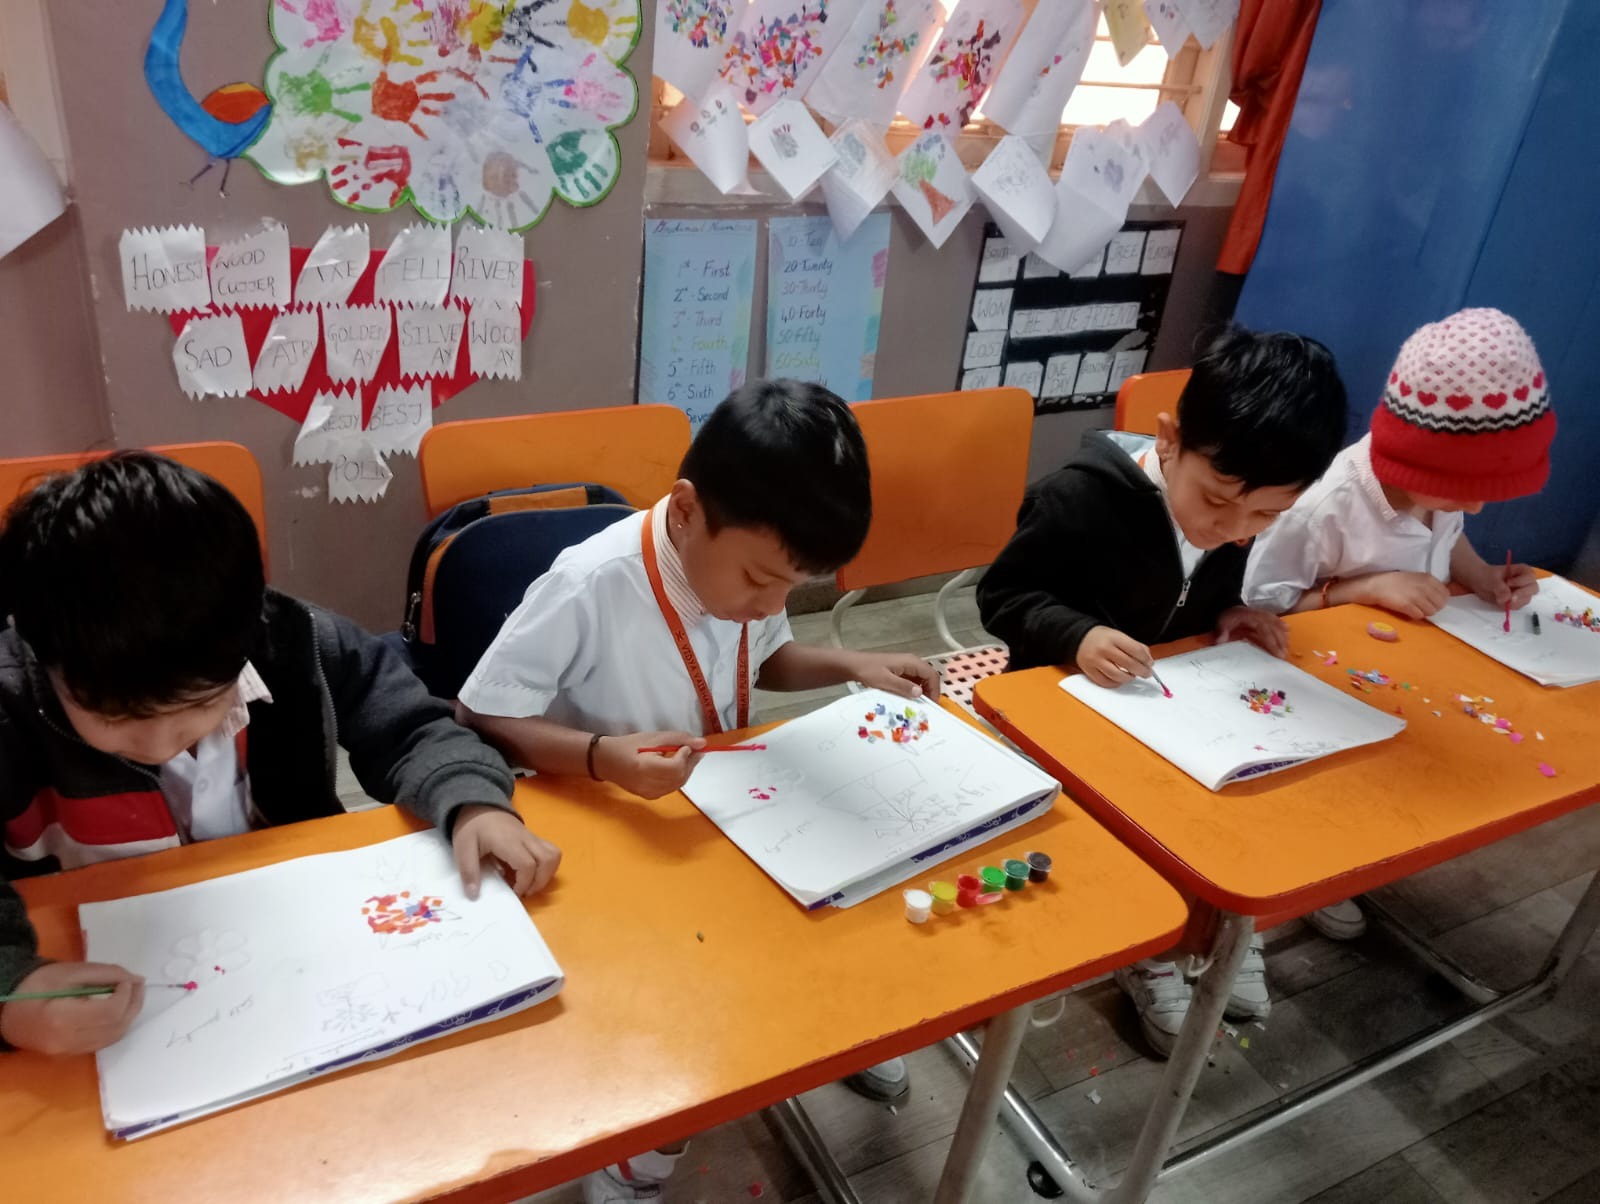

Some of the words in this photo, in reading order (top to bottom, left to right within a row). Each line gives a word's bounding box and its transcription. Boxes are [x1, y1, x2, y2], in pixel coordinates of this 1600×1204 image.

[456, 246, 519, 288] RIVER
[703, 260, 731, 278] First
[697, 286, 730, 303] Second
[184, 339, 233, 372] SAD
[682, 643, 697, 671] VIDYA
